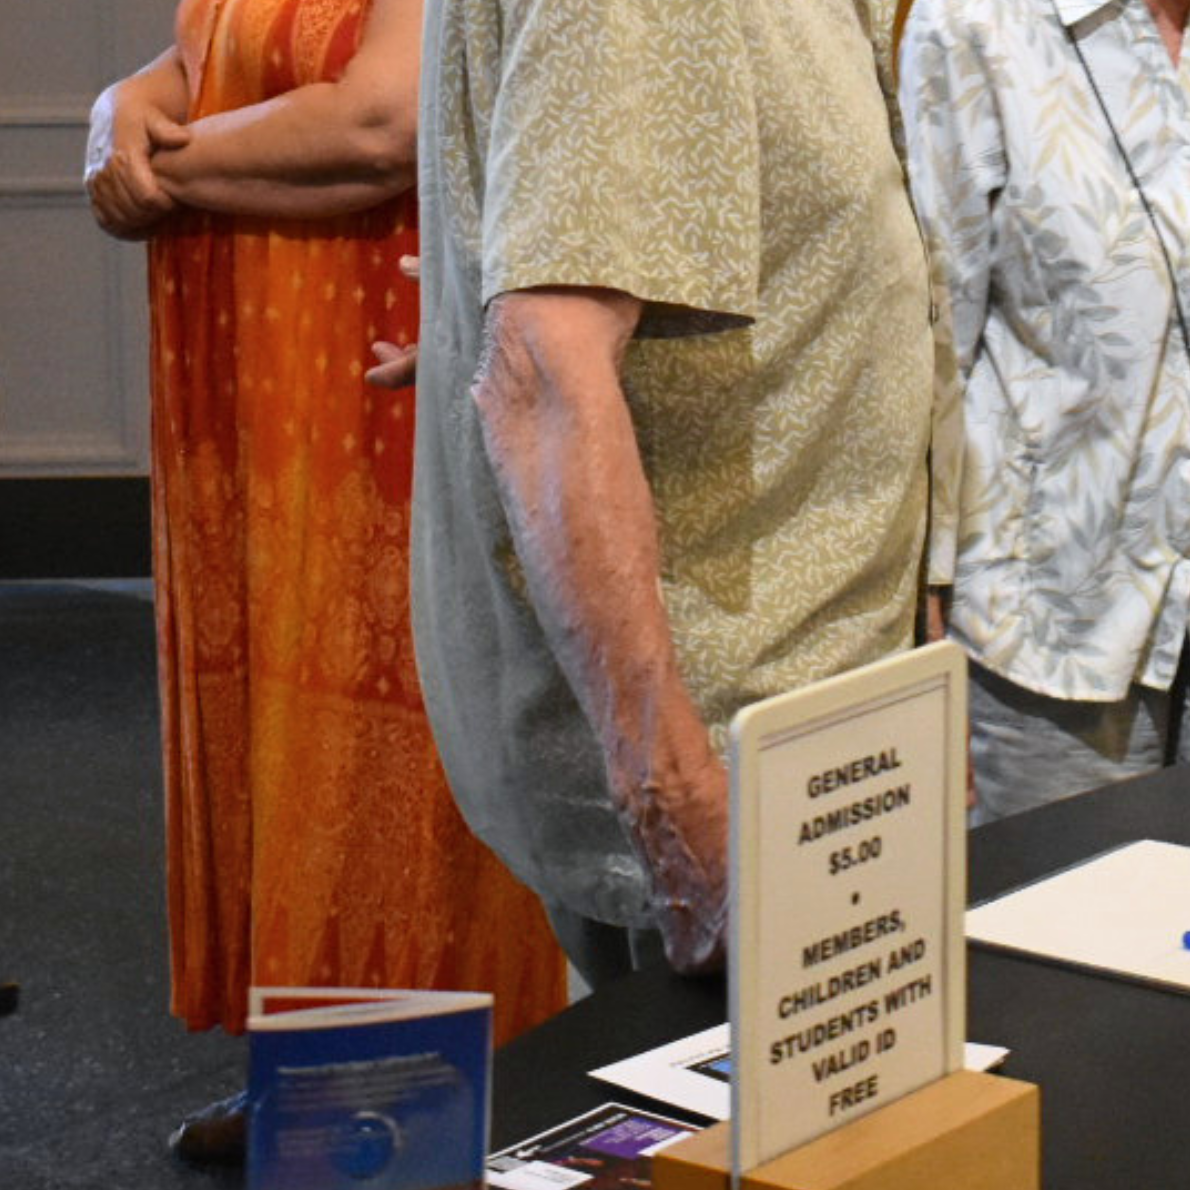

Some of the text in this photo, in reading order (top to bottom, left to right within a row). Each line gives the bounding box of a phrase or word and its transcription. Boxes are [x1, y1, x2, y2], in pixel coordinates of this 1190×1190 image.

[808, 748, 901, 799] GENERAL
[798, 783, 911, 846] ADMISSION
[829, 836, 882, 876] $5.00
[802, 909, 906, 968] MEMBERS,
[778, 938, 926, 1019] CHILDREN AND
[769, 973, 932, 1065] STUDENTS WITH
[811, 1027, 896, 1083] VALID ID
[828, 1074, 878, 1117] FREE
